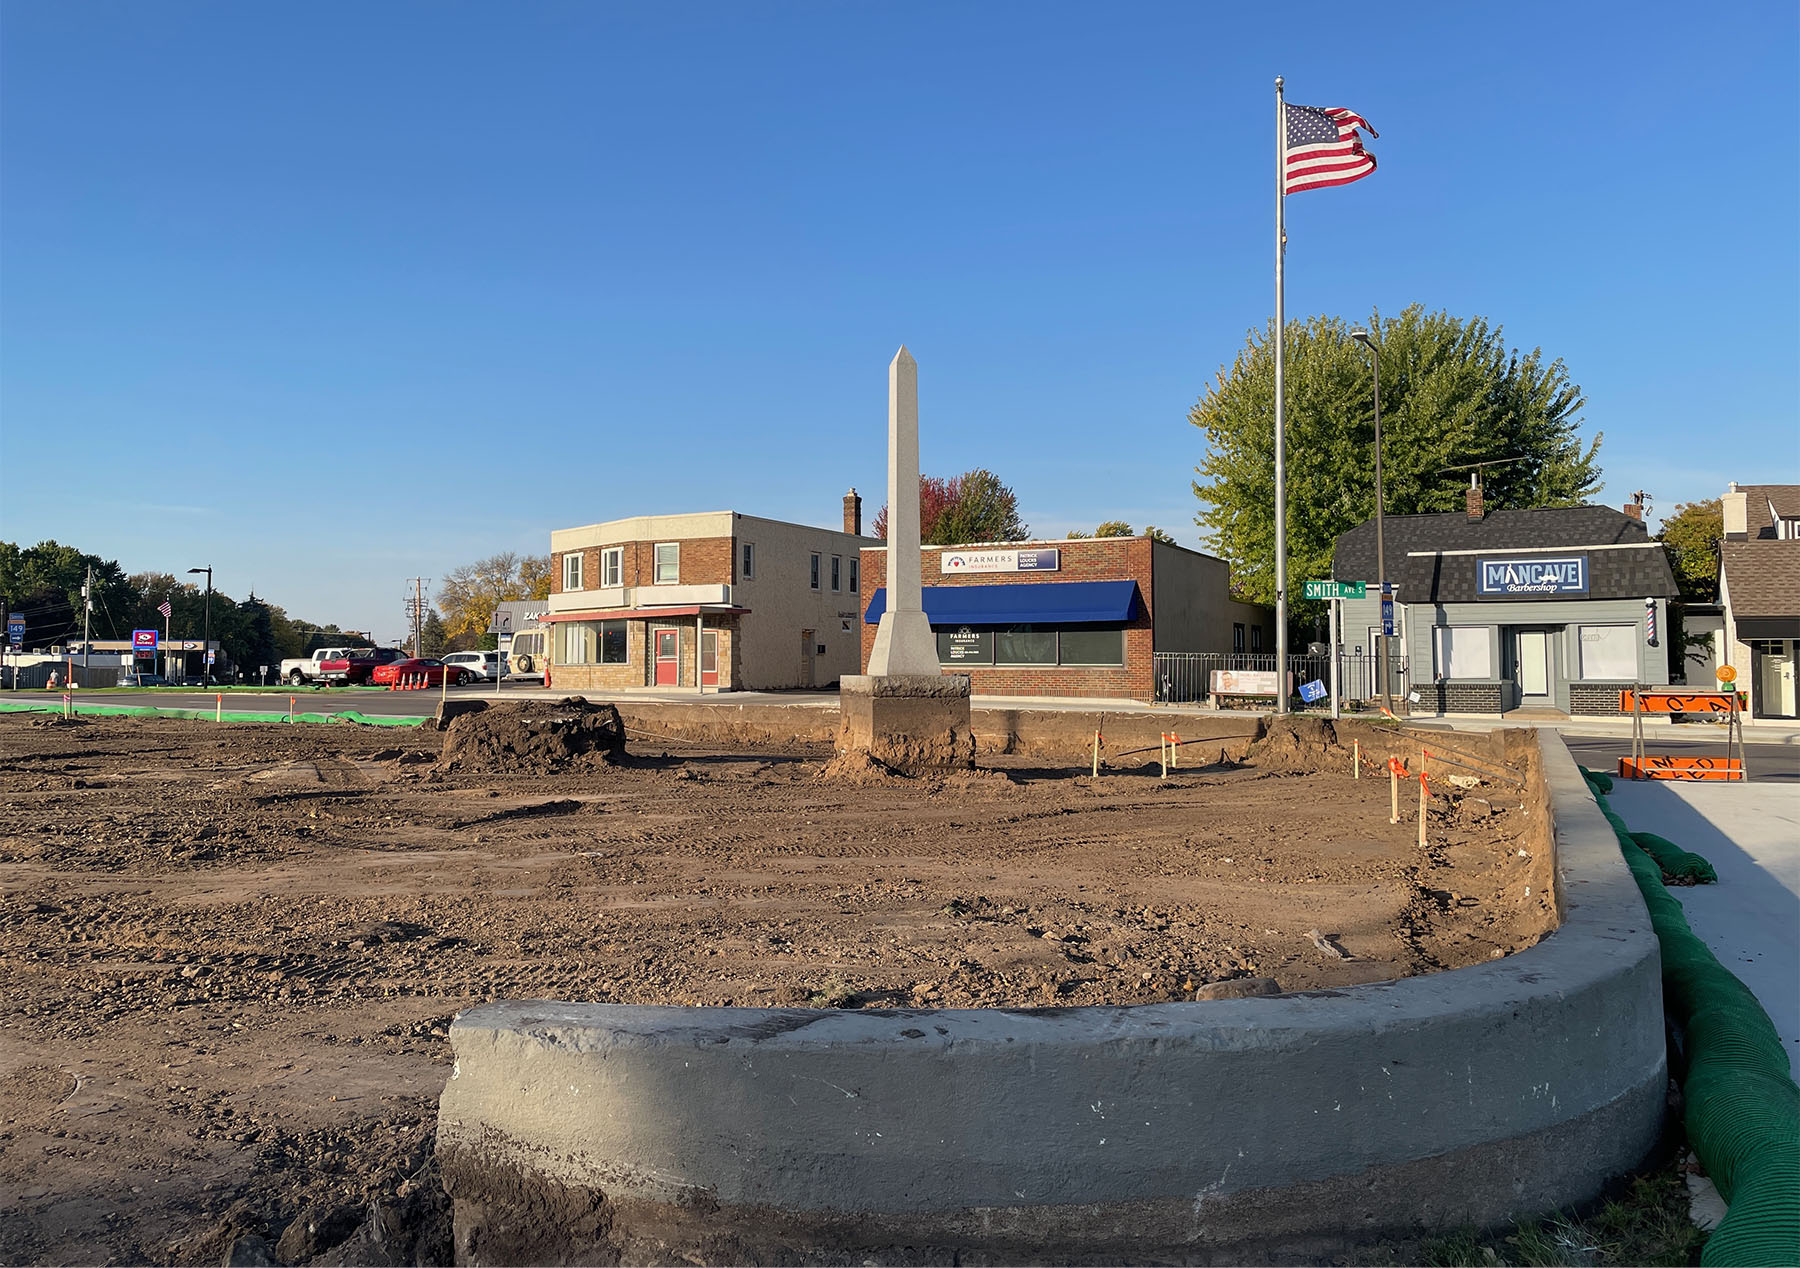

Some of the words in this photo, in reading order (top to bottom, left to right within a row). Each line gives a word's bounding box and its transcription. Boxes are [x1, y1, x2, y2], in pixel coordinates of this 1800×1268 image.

[968, 555, 1012, 563] FARMERS
[1488, 563, 1577, 585] MANCAVE
[1306, 583, 1340, 597] SMITH
[1344, 586, 1355, 594] AVE
[1358, 586, 1363, 594] S
[1506, 582, 1558, 594] Barbershop
[1383, 604, 1393, 616] 149
